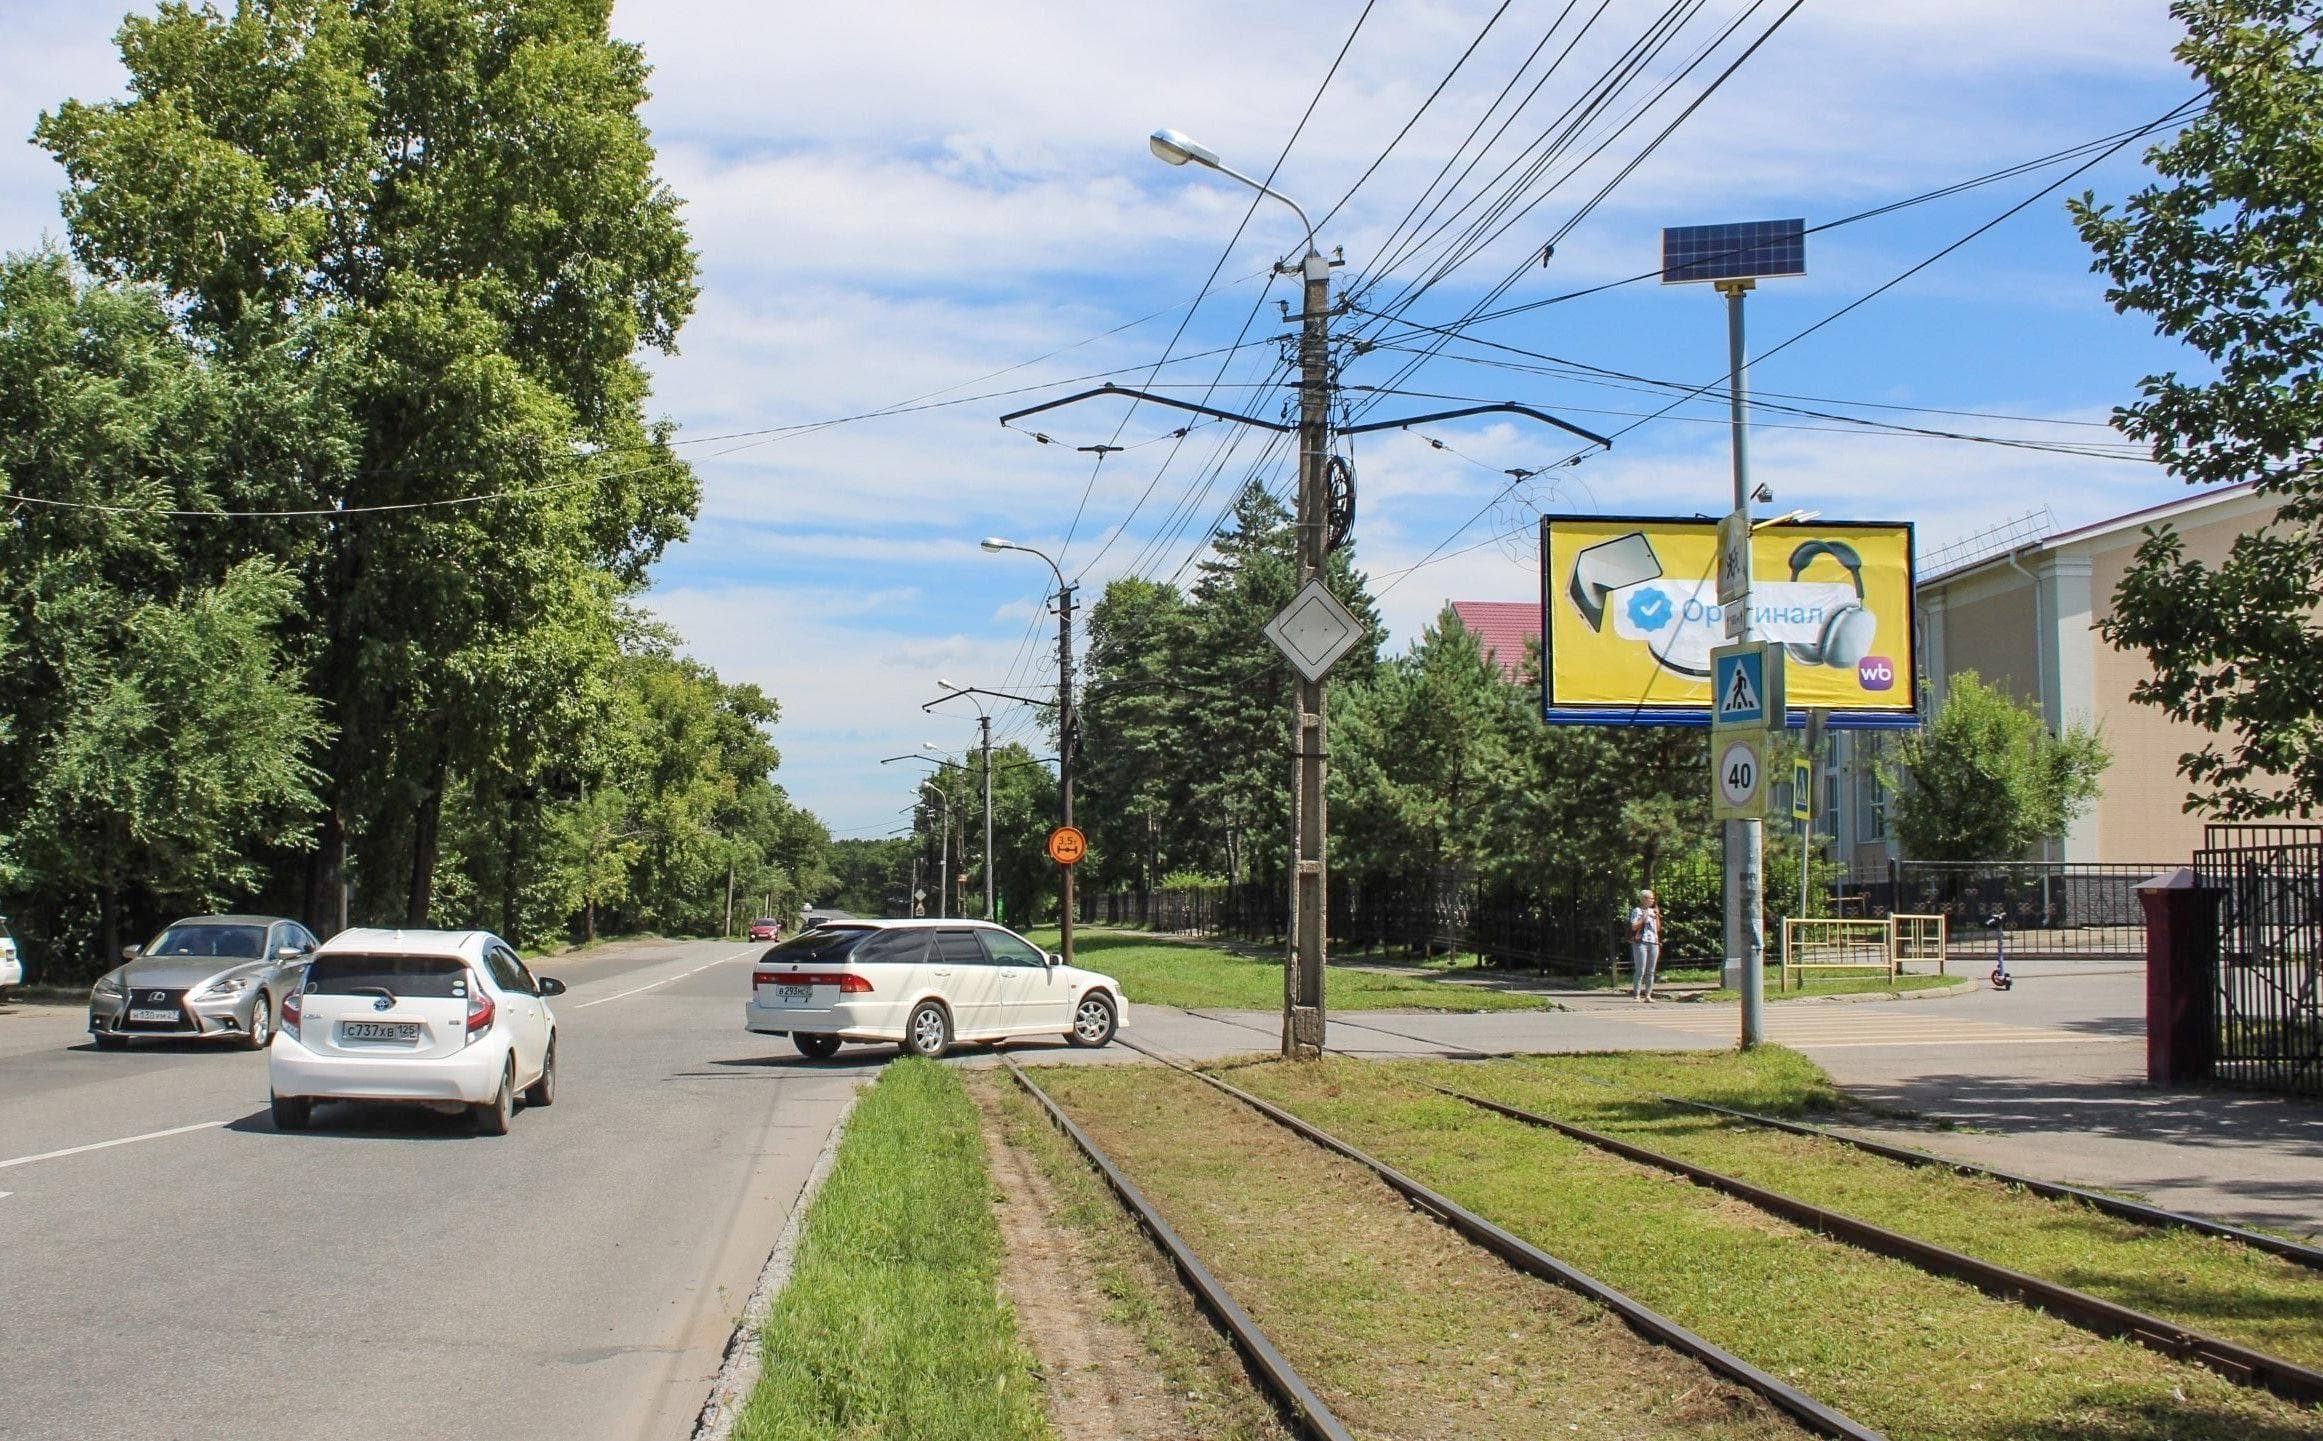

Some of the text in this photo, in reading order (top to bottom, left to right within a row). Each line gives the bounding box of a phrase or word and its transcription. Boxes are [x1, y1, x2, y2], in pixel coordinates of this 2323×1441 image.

[1683, 599, 1824, 628] Оринал
[1861, 666, 1892, 682] wb
[1728, 763, 1752, 789] 40
[347, 1024, 415, 1037] С737ХВ 125
